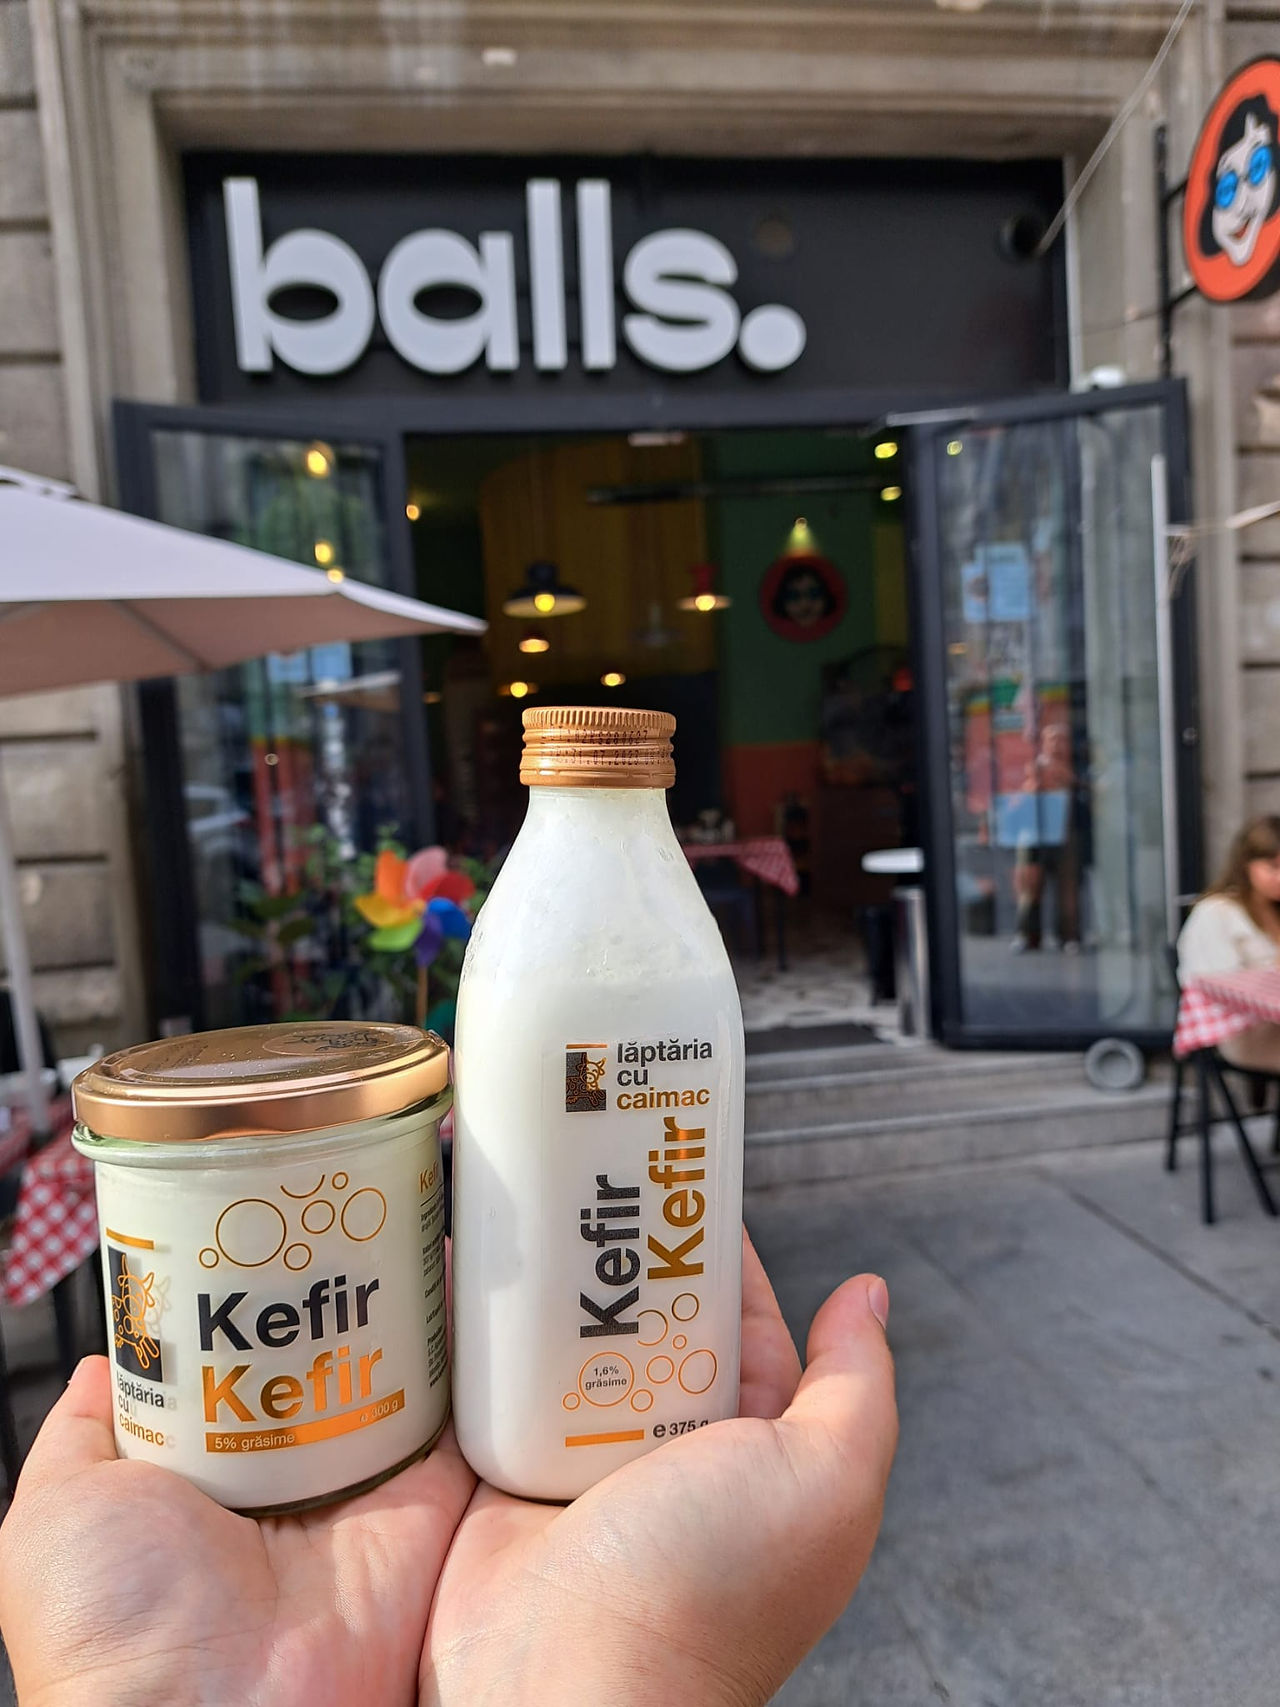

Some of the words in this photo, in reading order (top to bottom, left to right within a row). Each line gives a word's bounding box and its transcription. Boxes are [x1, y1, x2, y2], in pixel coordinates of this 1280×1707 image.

[222, 176, 807, 375] balls.
[616, 1038, 713, 1065] lăptăria
[616, 1067, 650, 1087] cu
[616, 1086, 711, 1111] caimac
[647, 1115, 707, 1280] Kefir
[579, 1174, 641, 1339] Kefir
[197, 1273, 381, 1352] Kefir
[201, 1345, 384, 1424] Kefir
[593, 1364, 620, 1378] 1,6%
[116, 1369, 165, 1408] lăptăria
[118, 1393, 130, 1413] cu
[118, 1413, 166, 1446] caimac
[669, 1419, 697, 1436] 375
[214, 1436, 238, 1451] 5%
[240, 1433, 297, 1453] grăsime
